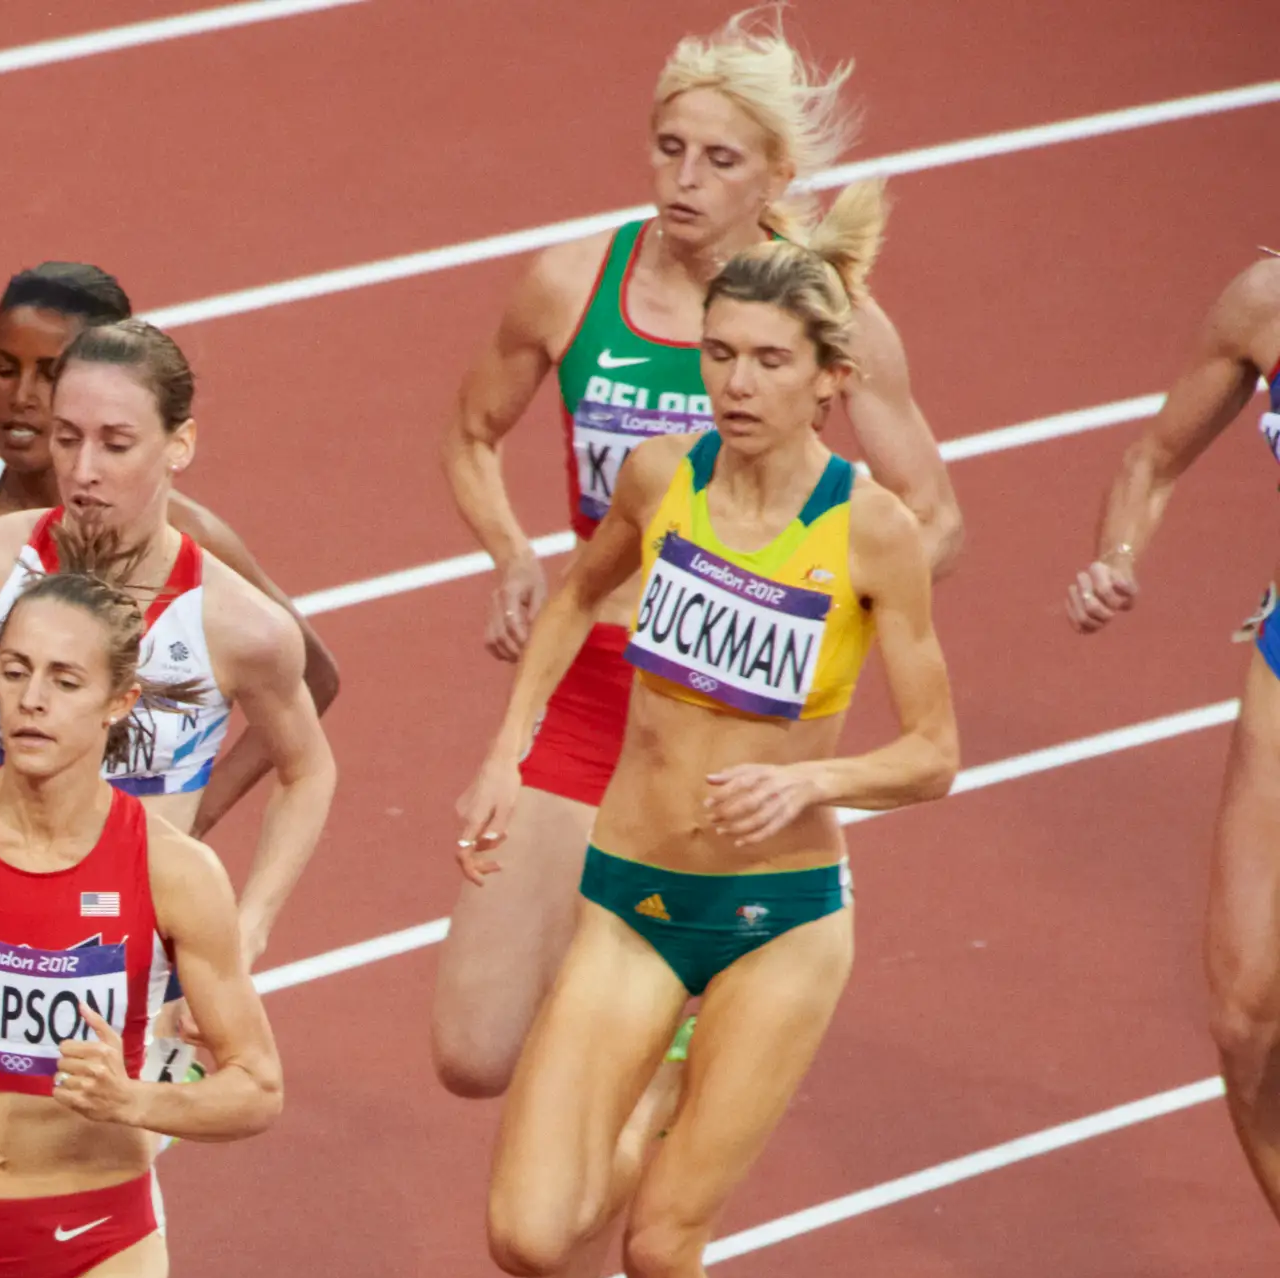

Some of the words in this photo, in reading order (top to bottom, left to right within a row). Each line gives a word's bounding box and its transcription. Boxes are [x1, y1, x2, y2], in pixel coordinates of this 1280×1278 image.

[621, 413, 686, 434] London
[690, 552, 745, 591] London
[745, 579, 787, 605] 2012
[636, 573, 814, 694] BUCKMAN
[37, 955, 80, 973] 2012
